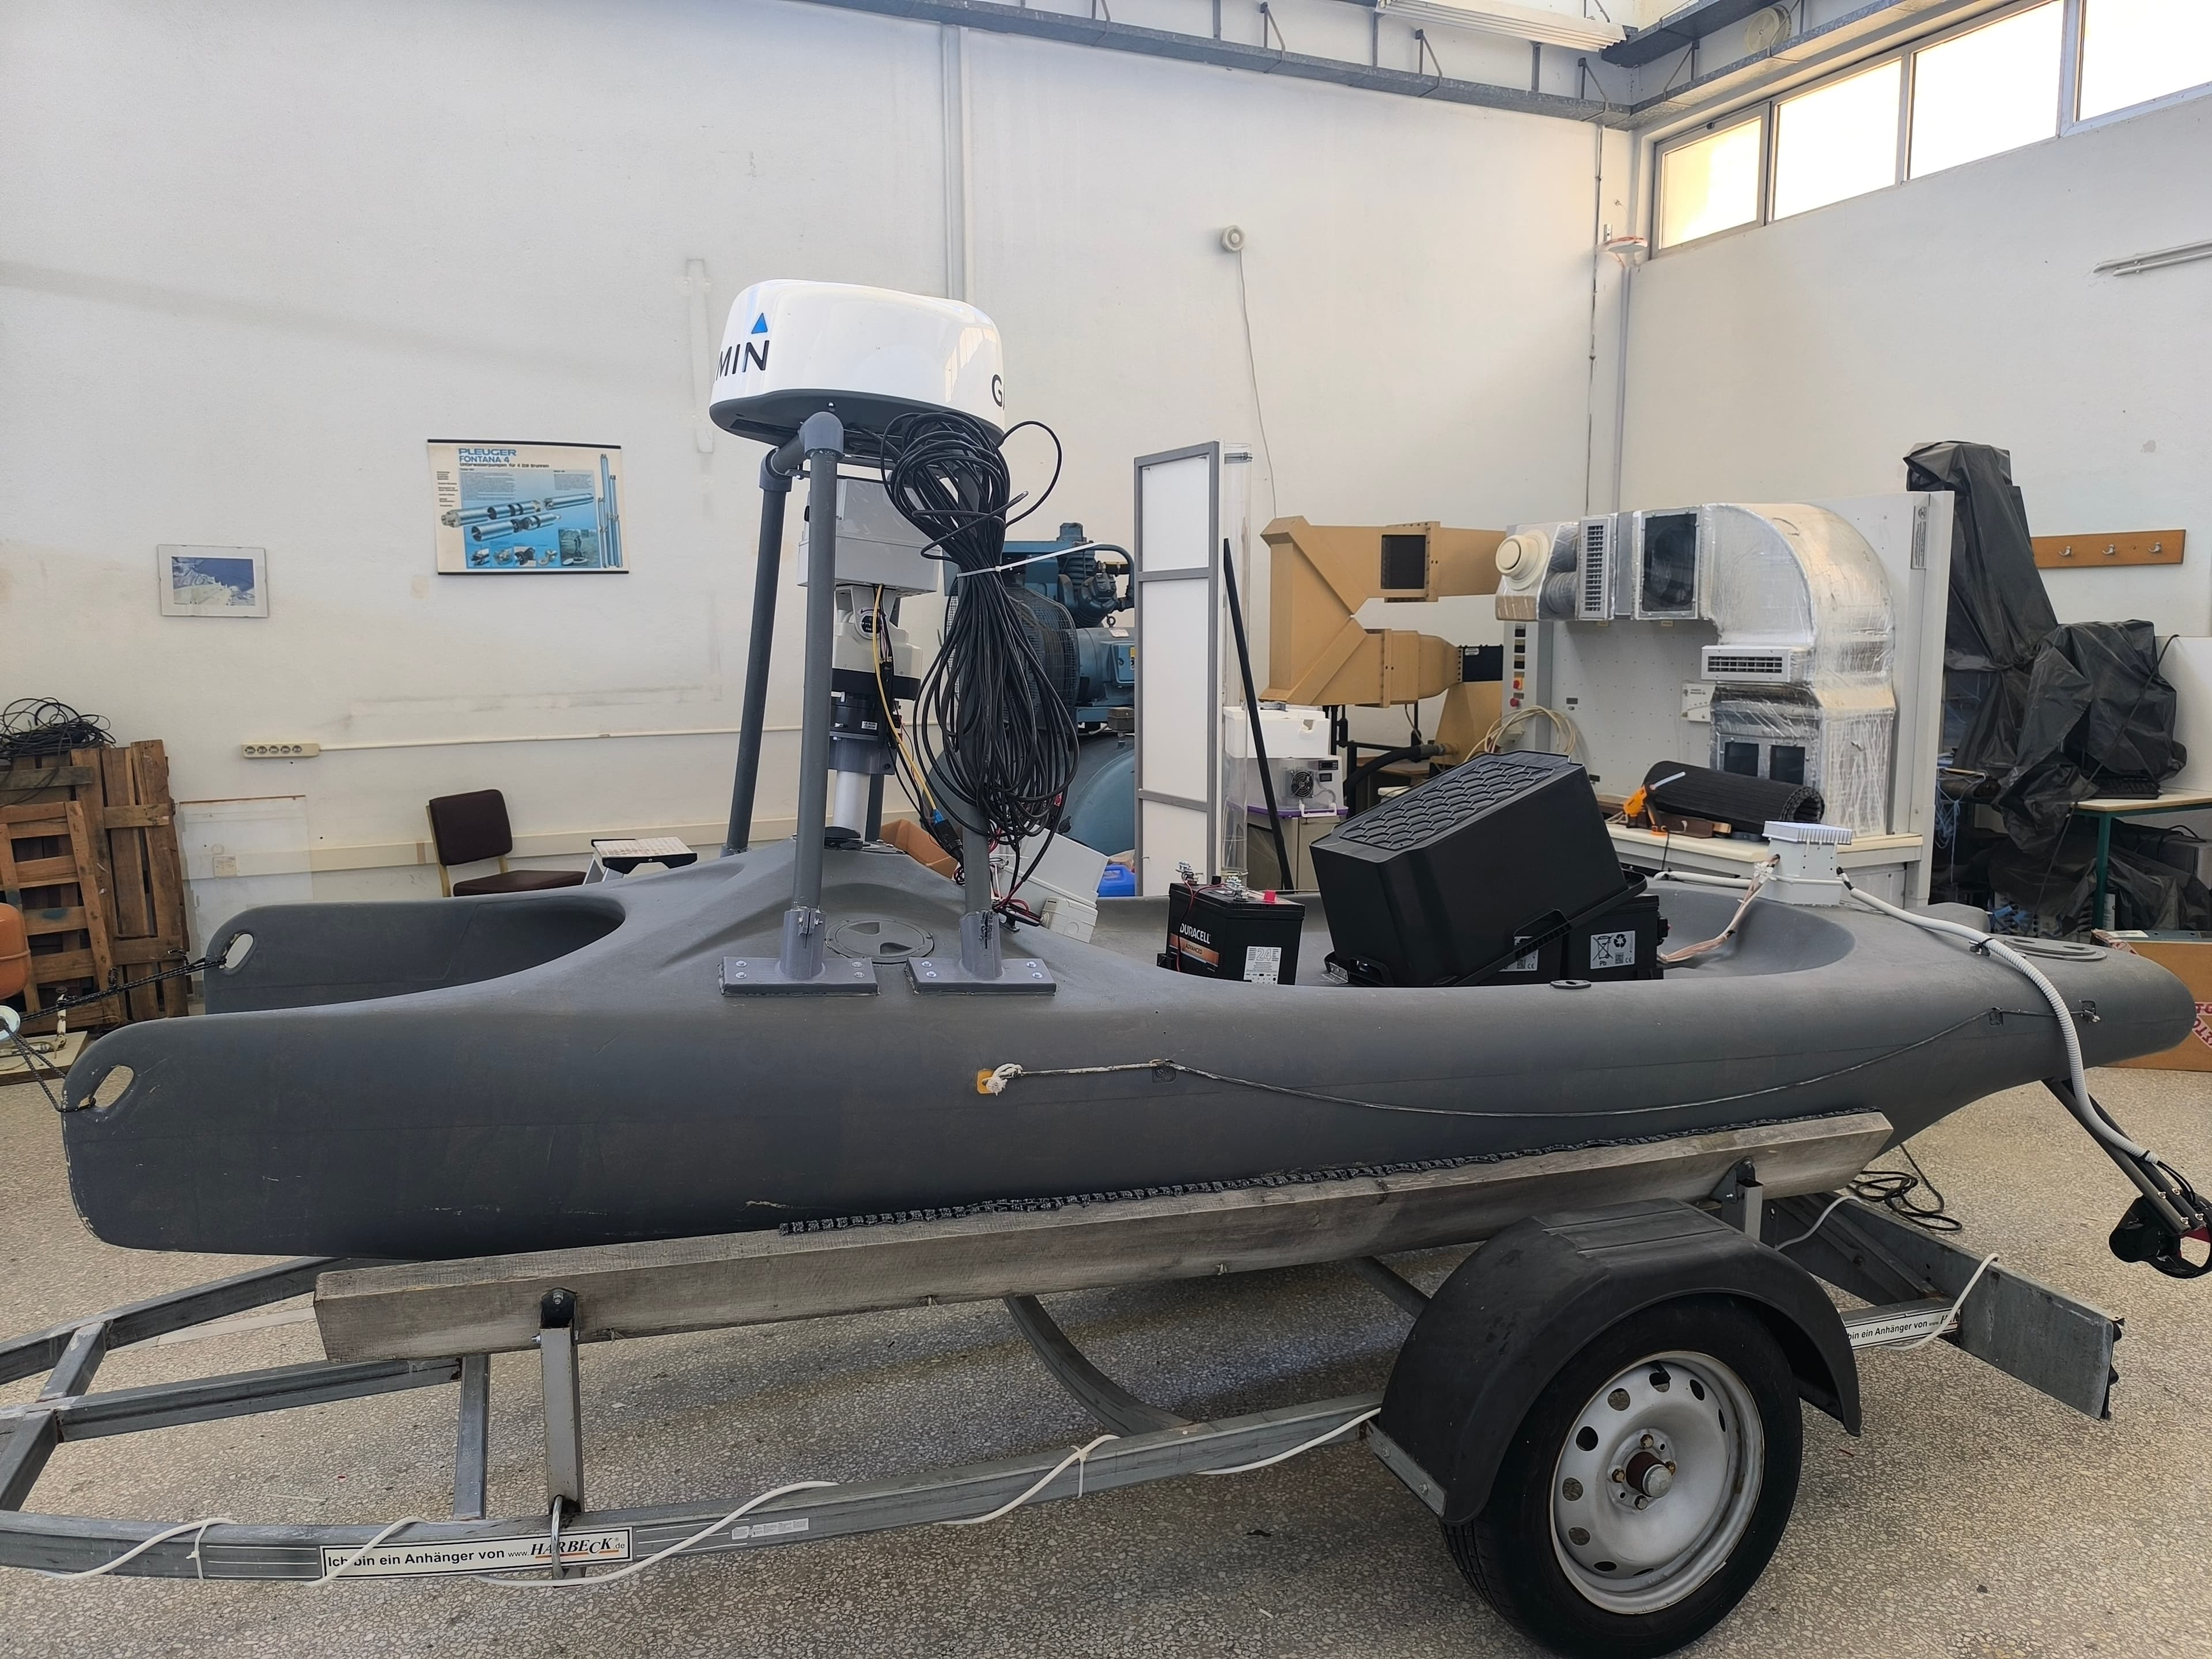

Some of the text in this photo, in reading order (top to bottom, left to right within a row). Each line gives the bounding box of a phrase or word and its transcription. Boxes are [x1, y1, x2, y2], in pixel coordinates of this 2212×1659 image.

[991, 373, 1005, 411] G
[459, 448, 517, 456] PLEUGER
[1180, 923, 1211, 945] DURACELL
[1185, 943, 1203, 955] ADVANCED
[1256, 948, 1272, 961] 24
[1847, 1331, 1859, 1340] bin
[1861, 1329, 1873, 1338] ein
[1874, 1324, 1912, 1336] Anhänger
[1914, 1320, 1927, 1329] von
[380, 1555, 400, 1565] ein
[404, 1552, 475, 1565] Anhänger
[478, 1550, 505, 1560] von
